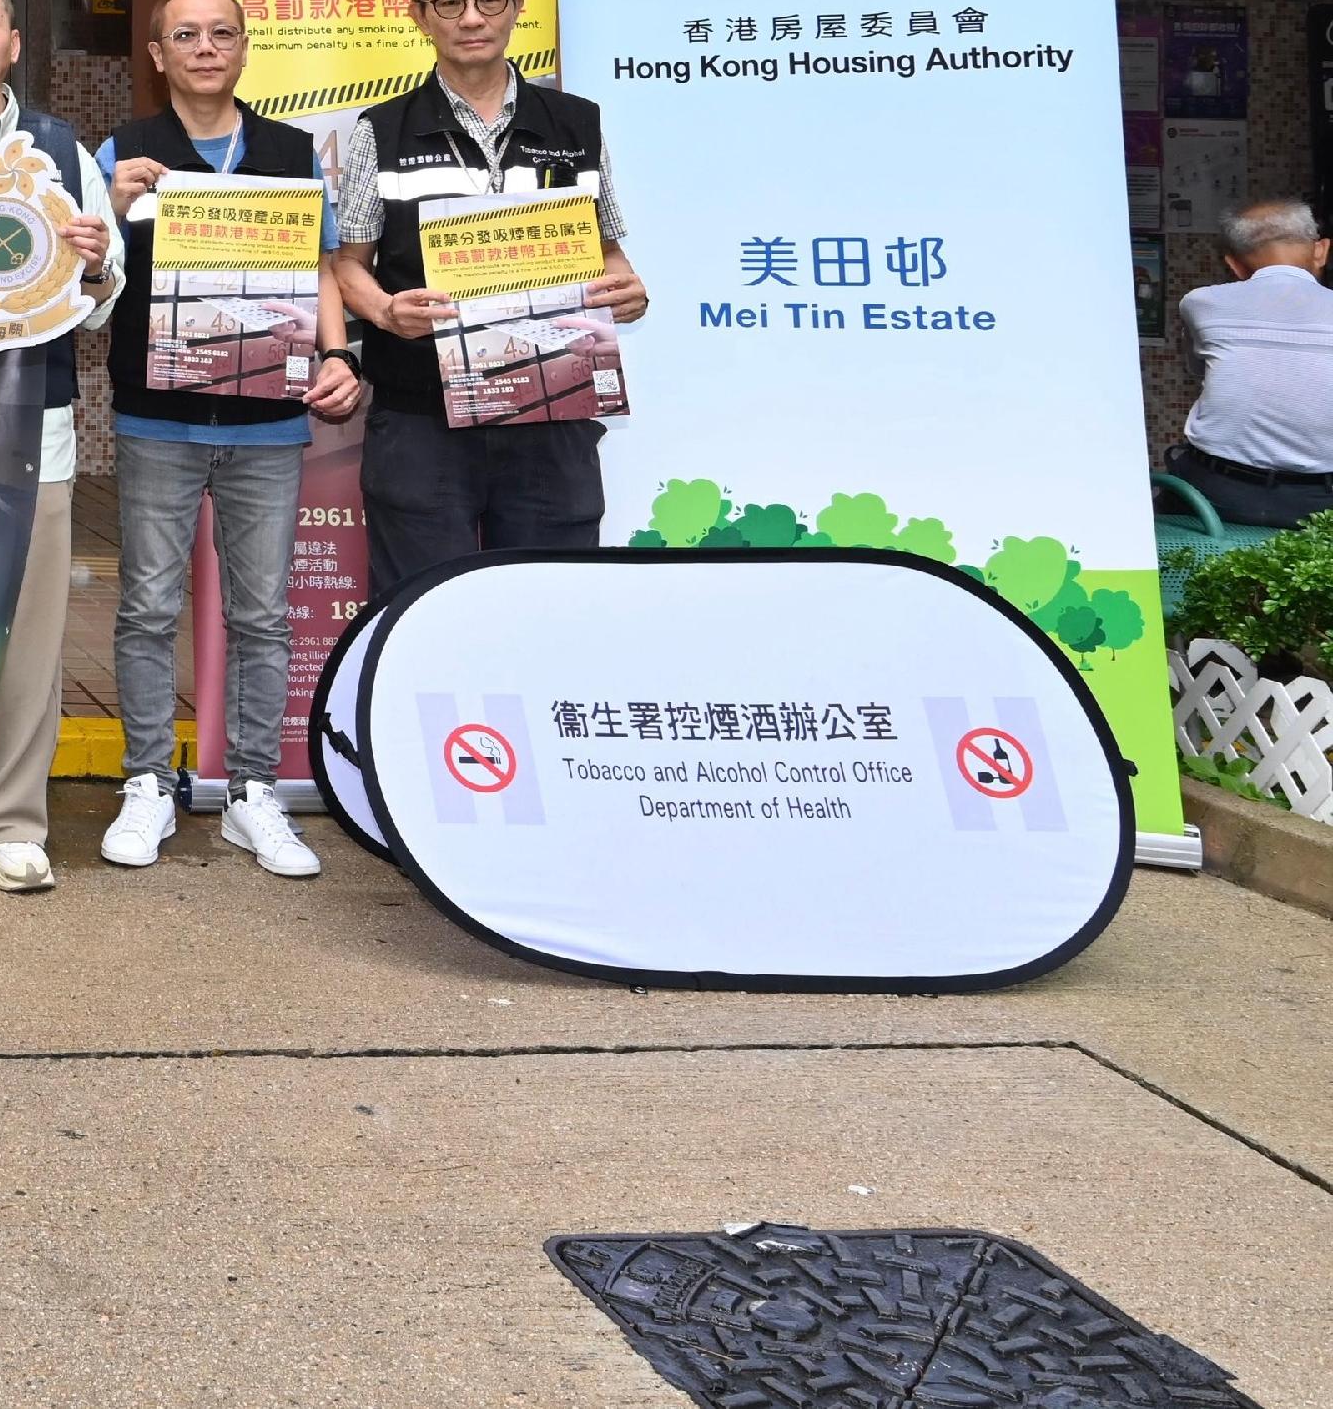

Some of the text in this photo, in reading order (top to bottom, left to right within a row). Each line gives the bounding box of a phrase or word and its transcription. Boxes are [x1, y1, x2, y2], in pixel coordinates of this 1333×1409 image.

[278, 25, 332, 36] distribute
[682, 6, 988, 44] 香港房屋委員會
[253, 43, 302, 51] maximum
[307, 39, 348, 51] penalty
[614, 44, 1073, 83] Hong Kong Housing Authority
[741, 236, 947, 287] 美田邨
[700, 303, 996, 331] Mei Tin Estate
[299, 508, 354, 526] 2961
[562, 758, 913, 784] Tobacco and Alcohol Control Office
[639, 795, 851, 822] Department of Health
